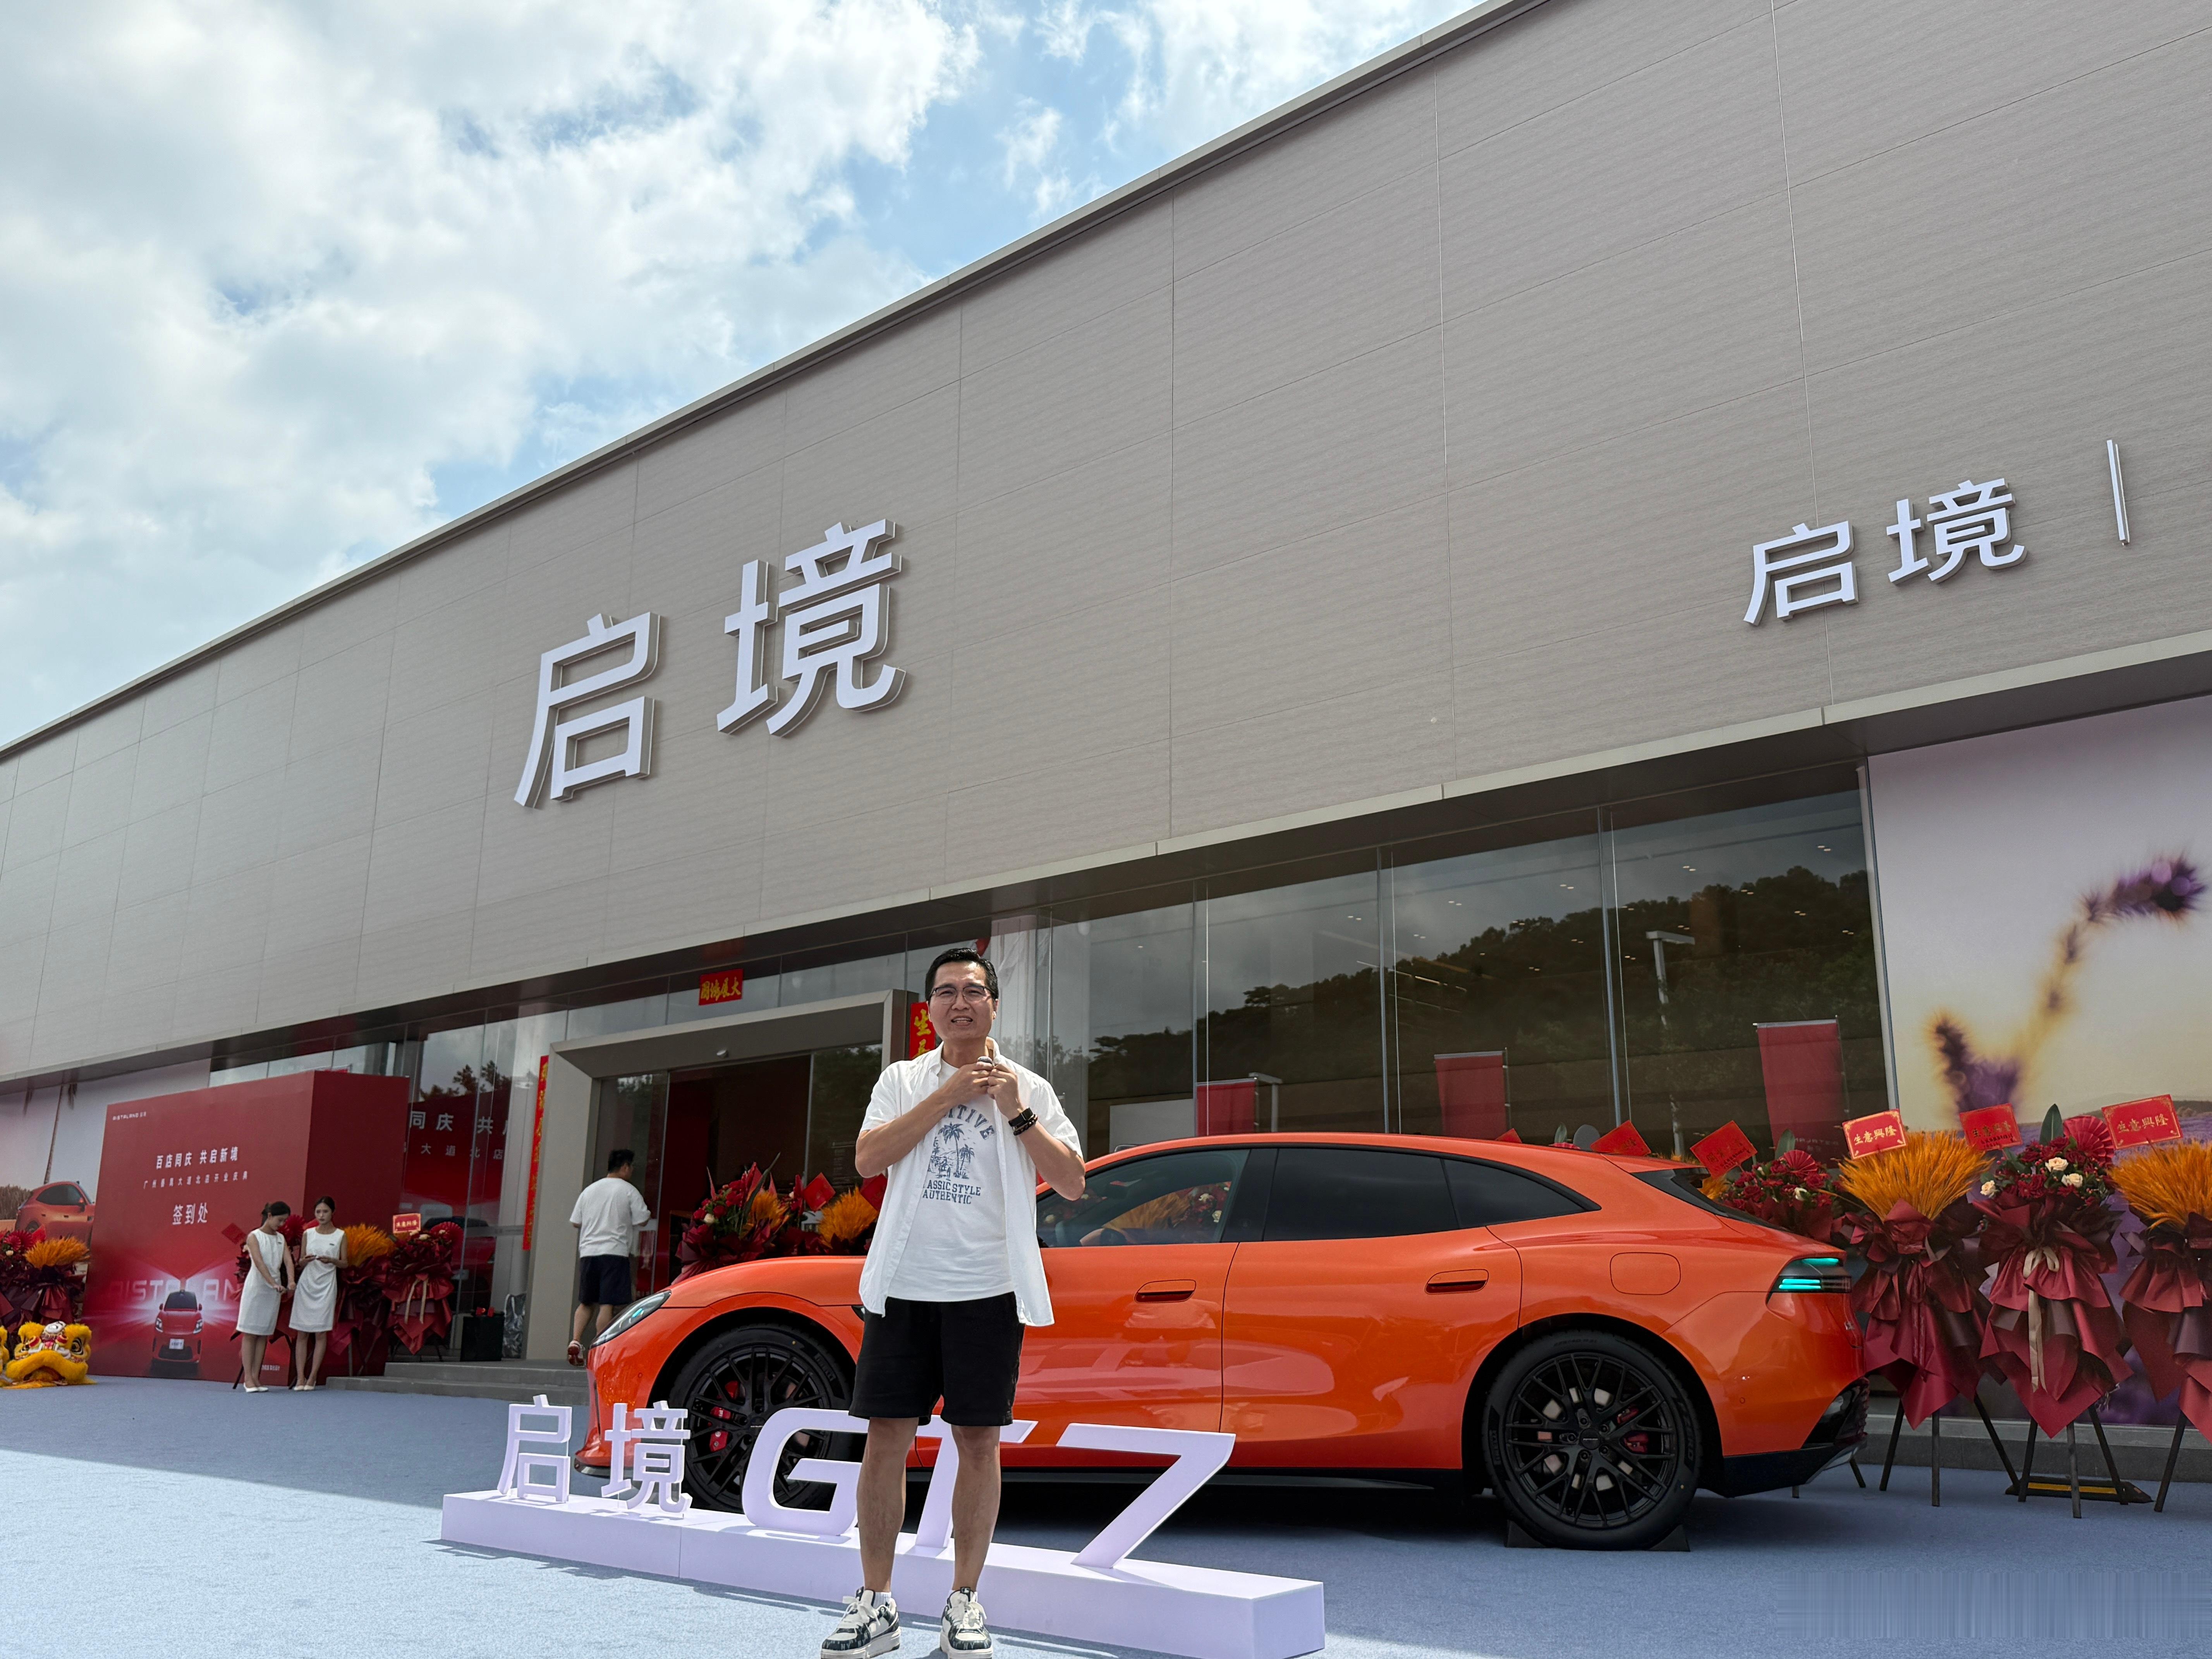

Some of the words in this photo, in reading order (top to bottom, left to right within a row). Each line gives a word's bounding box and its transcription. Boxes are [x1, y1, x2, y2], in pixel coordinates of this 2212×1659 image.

[1743, 478, 2028, 626] 启境
[514, 519, 906, 808] 启境
[410, 1110, 454, 1132] 同庆
[944, 1104, 995, 1140] ITIVE
[1854, 1125, 1897, 1146] 生意興隆
[156, 1152, 192, 1169] 百店同庆
[200, 1146, 238, 1164] 共启新境
[922, 1189, 972, 1204] AUTHENTIC
[923, 1180, 951, 1191] ASSIC
[952, 1183, 981, 1196] STYLE
[172, 1202, 208, 1224] 签到处
[497, 1394, 693, 1513] 启境
[741, 1407, 1236, 1569] GT7
